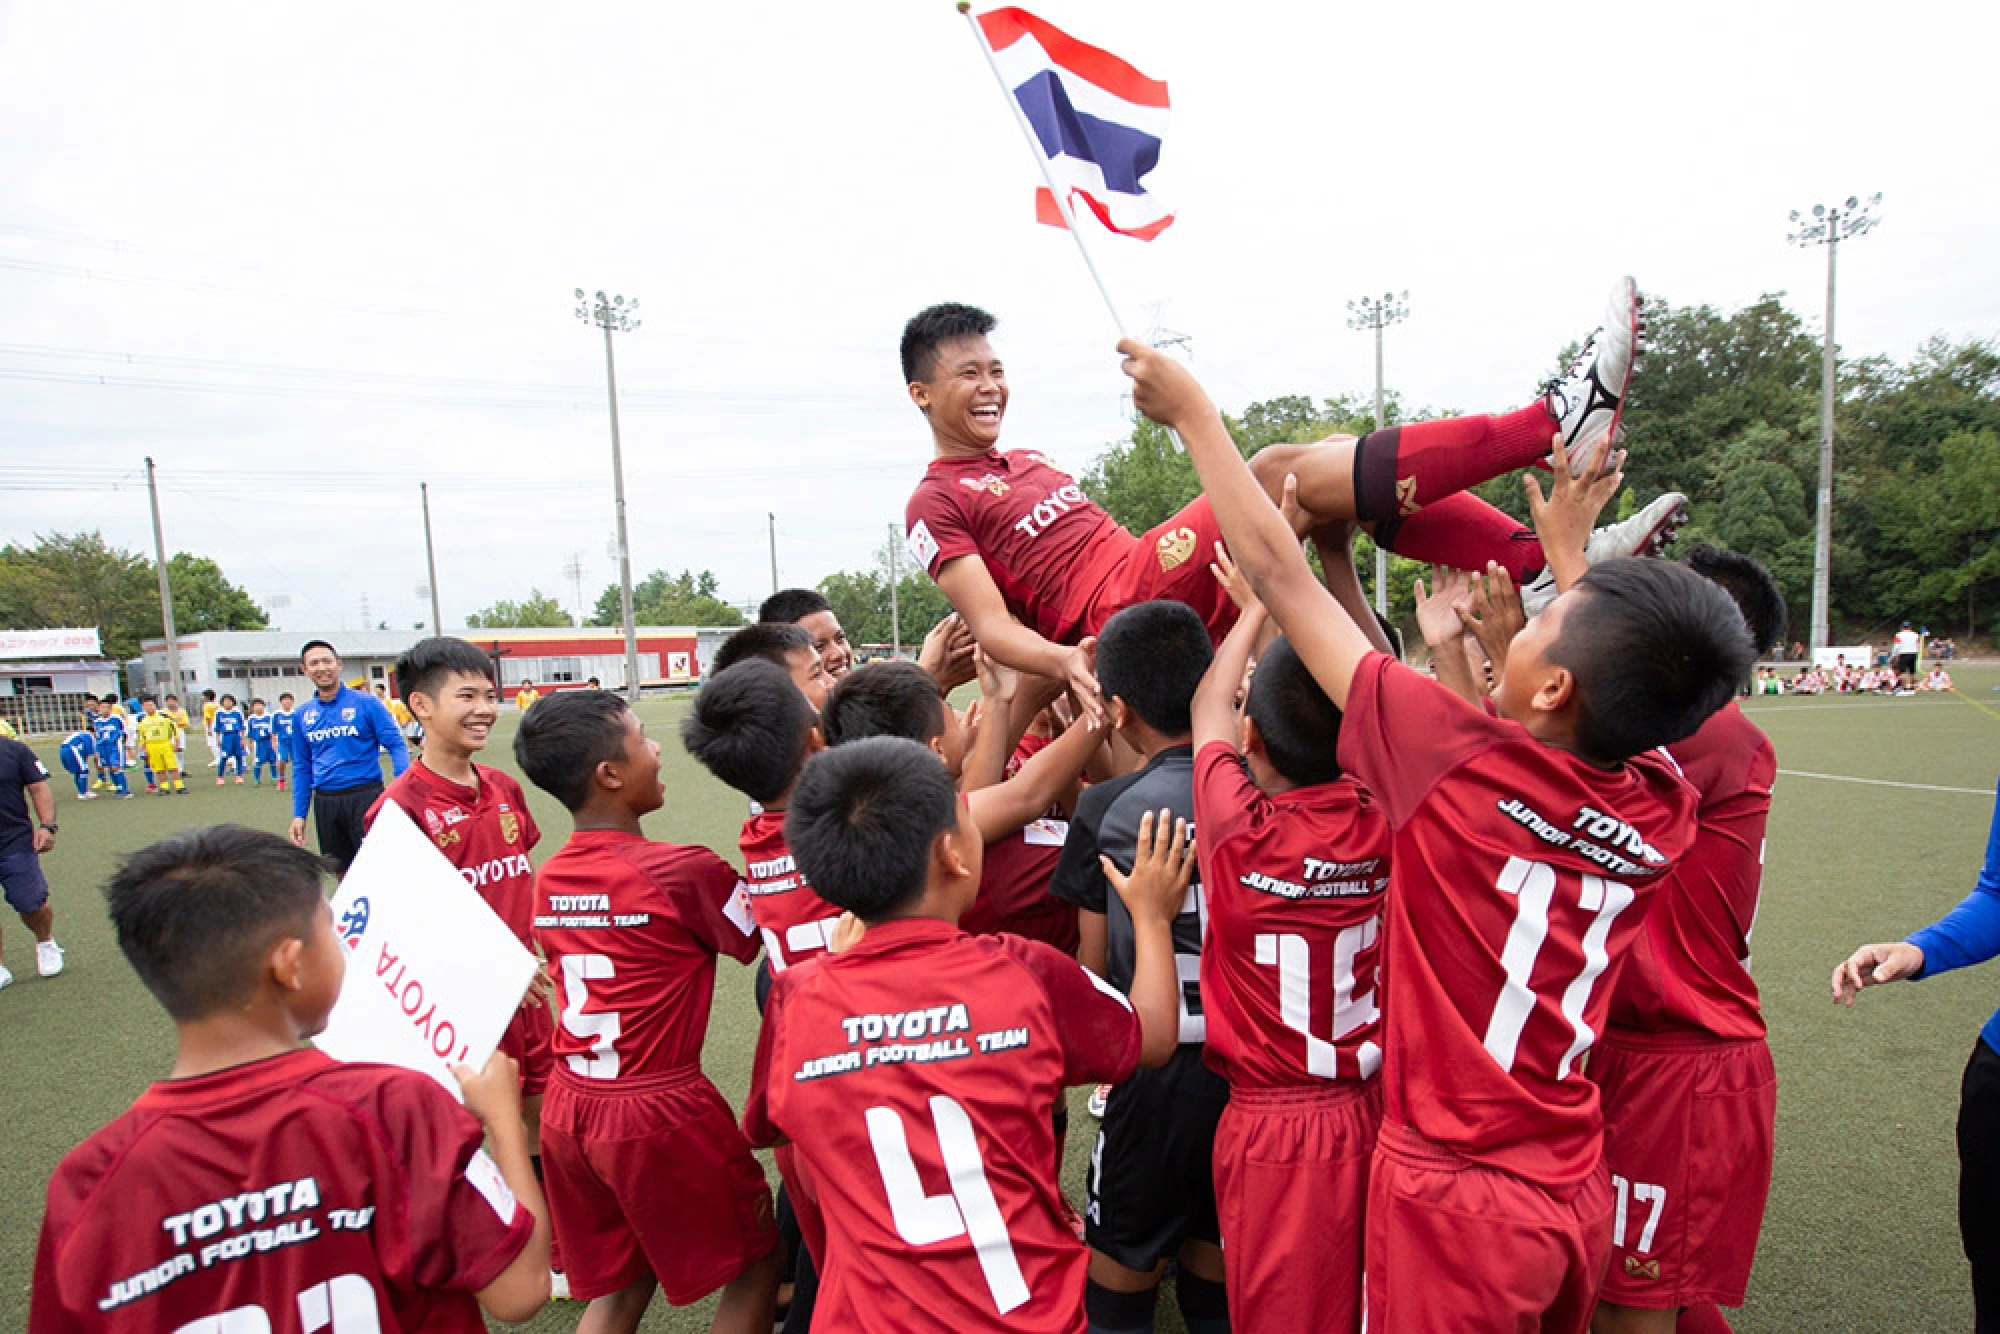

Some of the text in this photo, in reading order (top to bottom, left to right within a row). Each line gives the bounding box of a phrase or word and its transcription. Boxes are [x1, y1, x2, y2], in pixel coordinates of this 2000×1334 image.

[1015, 485, 1083, 538] TOYO
[308, 725, 358, 742] TOYOTA
[458, 854, 531, 886] OYOTA
[549, 893, 611, 912] TOYOTA
[560, 954, 621, 1080] 5
[842, 1003, 970, 1045] TOYOTA
[794, 1027, 1029, 1081] JUNIOR FOOTBALL TEAM
[865, 1095, 1032, 1315] 4
[1612, 1174, 1667, 1254] 17
[97, 1252, 197, 1311] JUNIOR
